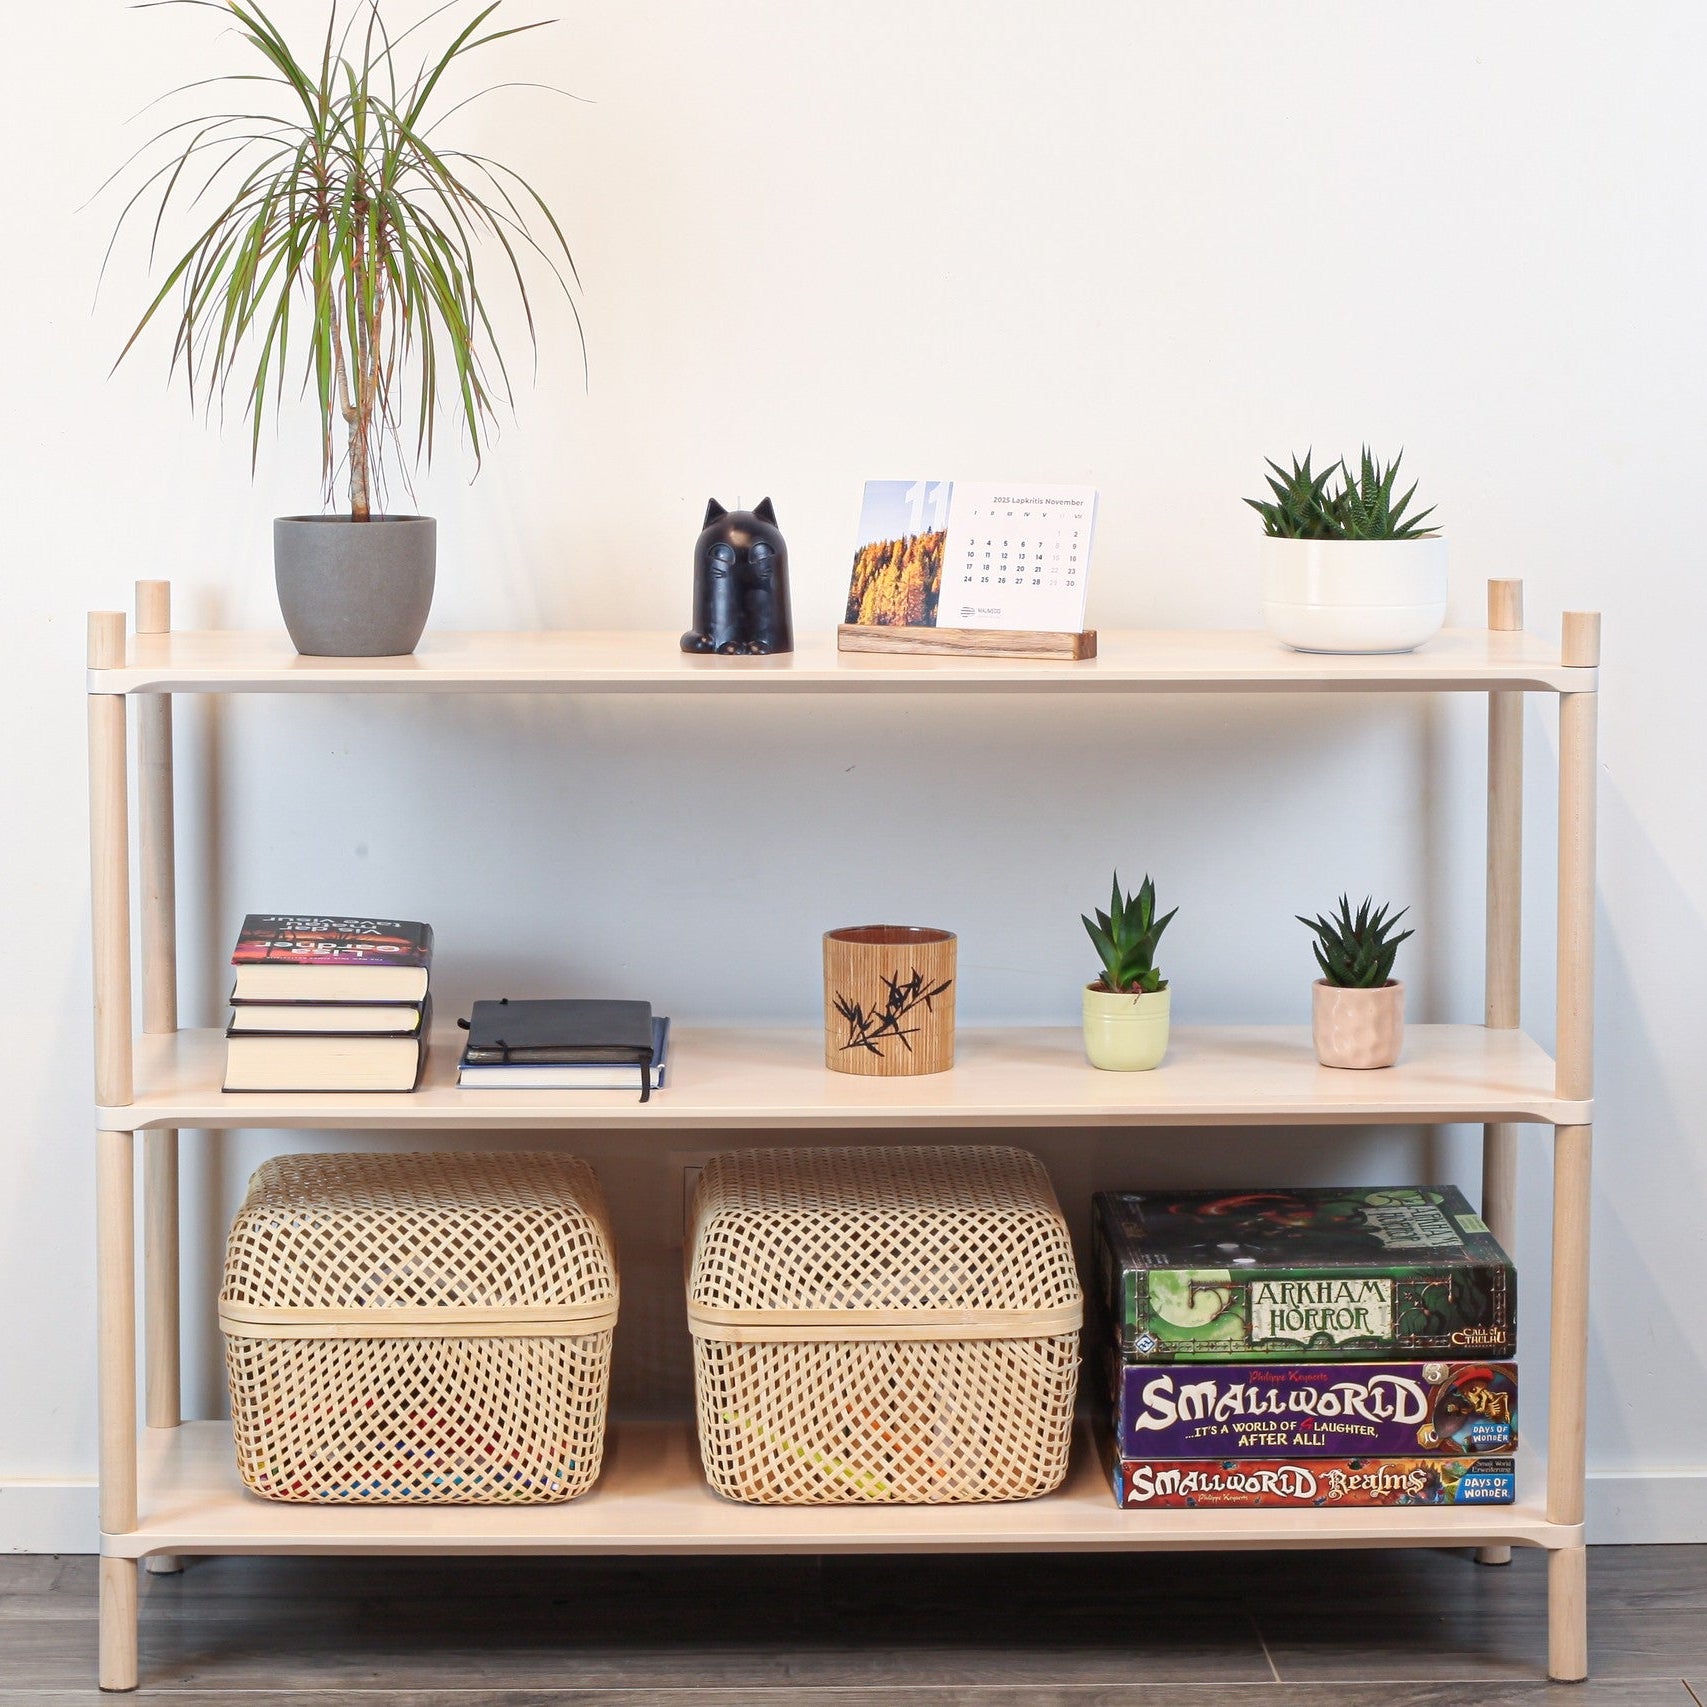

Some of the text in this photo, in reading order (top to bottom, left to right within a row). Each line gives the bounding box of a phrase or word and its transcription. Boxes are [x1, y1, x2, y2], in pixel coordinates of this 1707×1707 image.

[904, 479, 950, 531] 11
[993, 496, 1084, 506] 2025 Lapkritis November
[291, 948, 363, 957] Lisa
[1255, 1281, 1387, 1308] ARKHAM
[1270, 1307, 1375, 1336] HORROR
[1451, 1331, 1506, 1345] CTHULHU
[1463, 1328, 1488, 1337] CALL
[1249, 1370, 1286, 1384] Philippe
[1135, 1374, 1428, 1432] SMALLWORLD
[1220, 1424, 1229, 1434] A
[1232, 1420, 1276, 1432] WORLD
[1280, 1421, 1297, 1431] OF
[1472, 1425, 1509, 1434] DAYS OF
[1238, 1433, 1325, 1447] AFTER ALL!
[1472, 1434, 1509, 1443] WONDER
[1128, 1463, 1427, 1503] SMALLWORLD Realms
[1464, 1478, 1508, 1487] DAYS OF
[1464, 1488, 1509, 1499] WONDER
